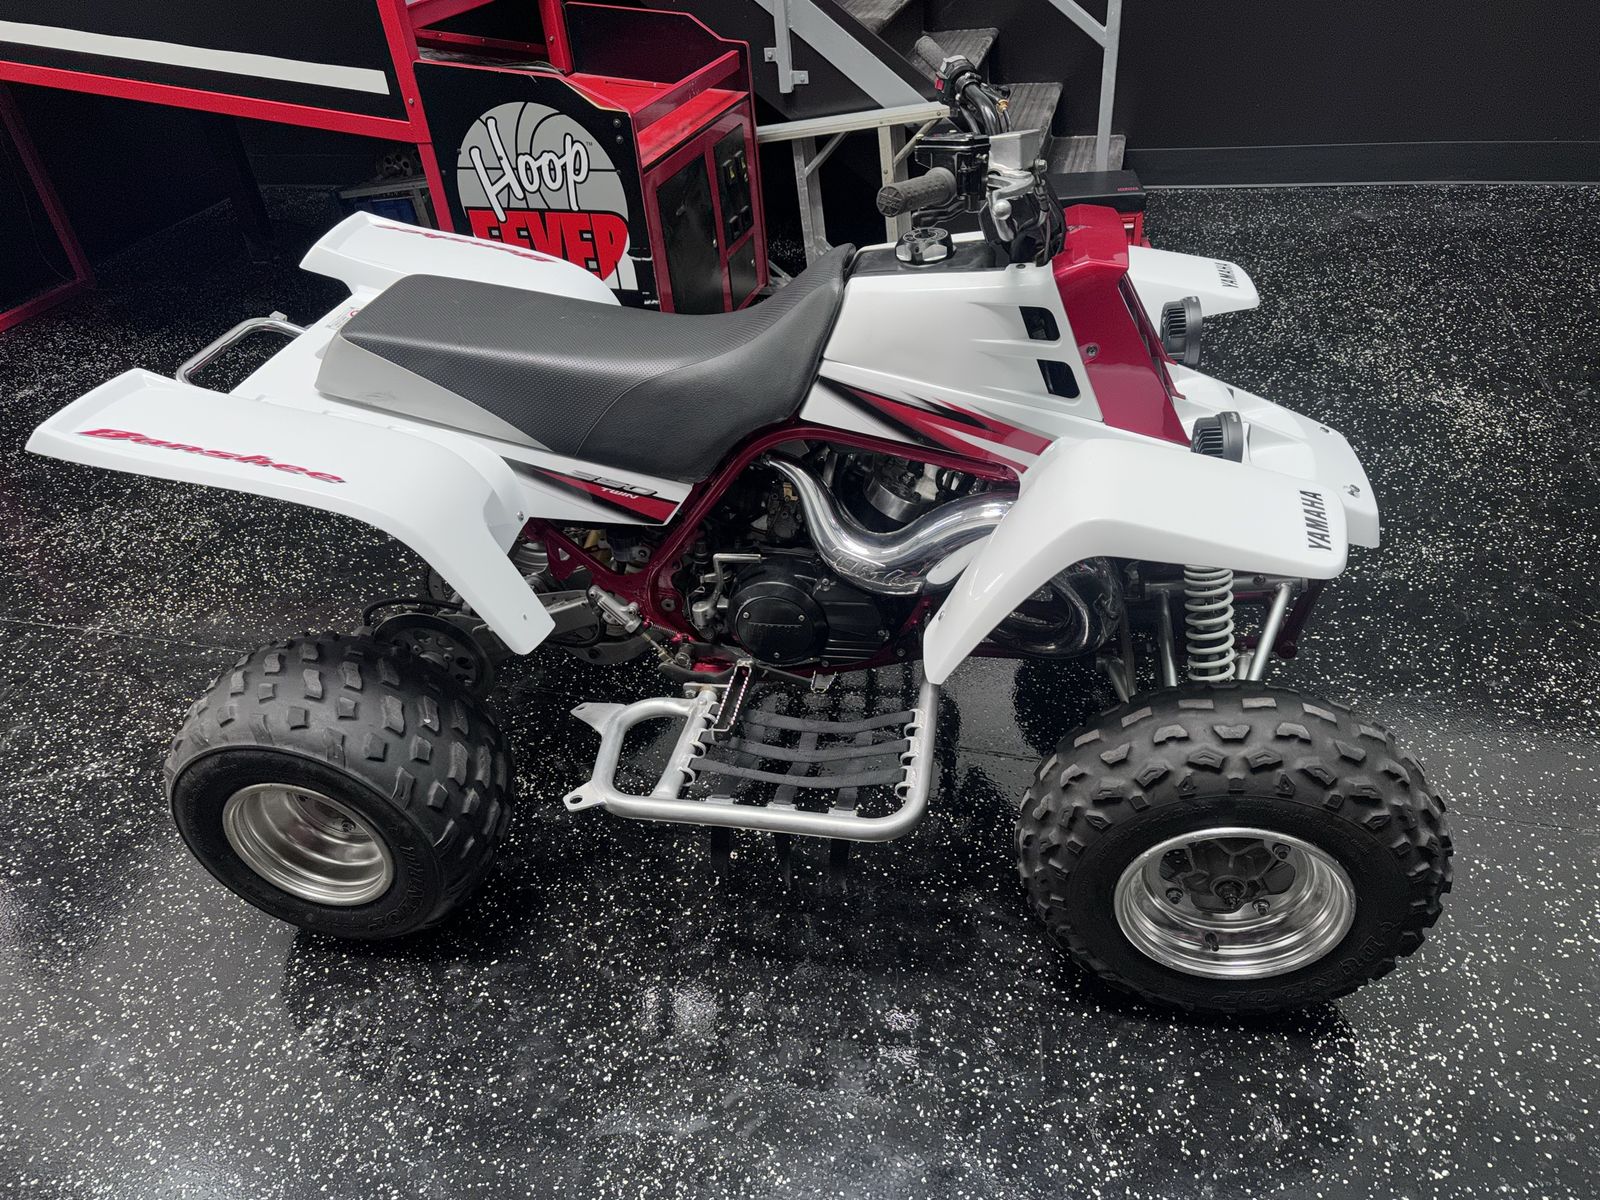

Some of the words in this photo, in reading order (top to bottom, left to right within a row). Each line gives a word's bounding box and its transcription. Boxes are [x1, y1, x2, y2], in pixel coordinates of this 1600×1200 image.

[469, 116, 590, 223] Hoop
[1214, 262, 1239, 289] YAMAHA
[75, 428, 346, 483] Banshee
[1299, 489, 1332, 551] YAMAHA
